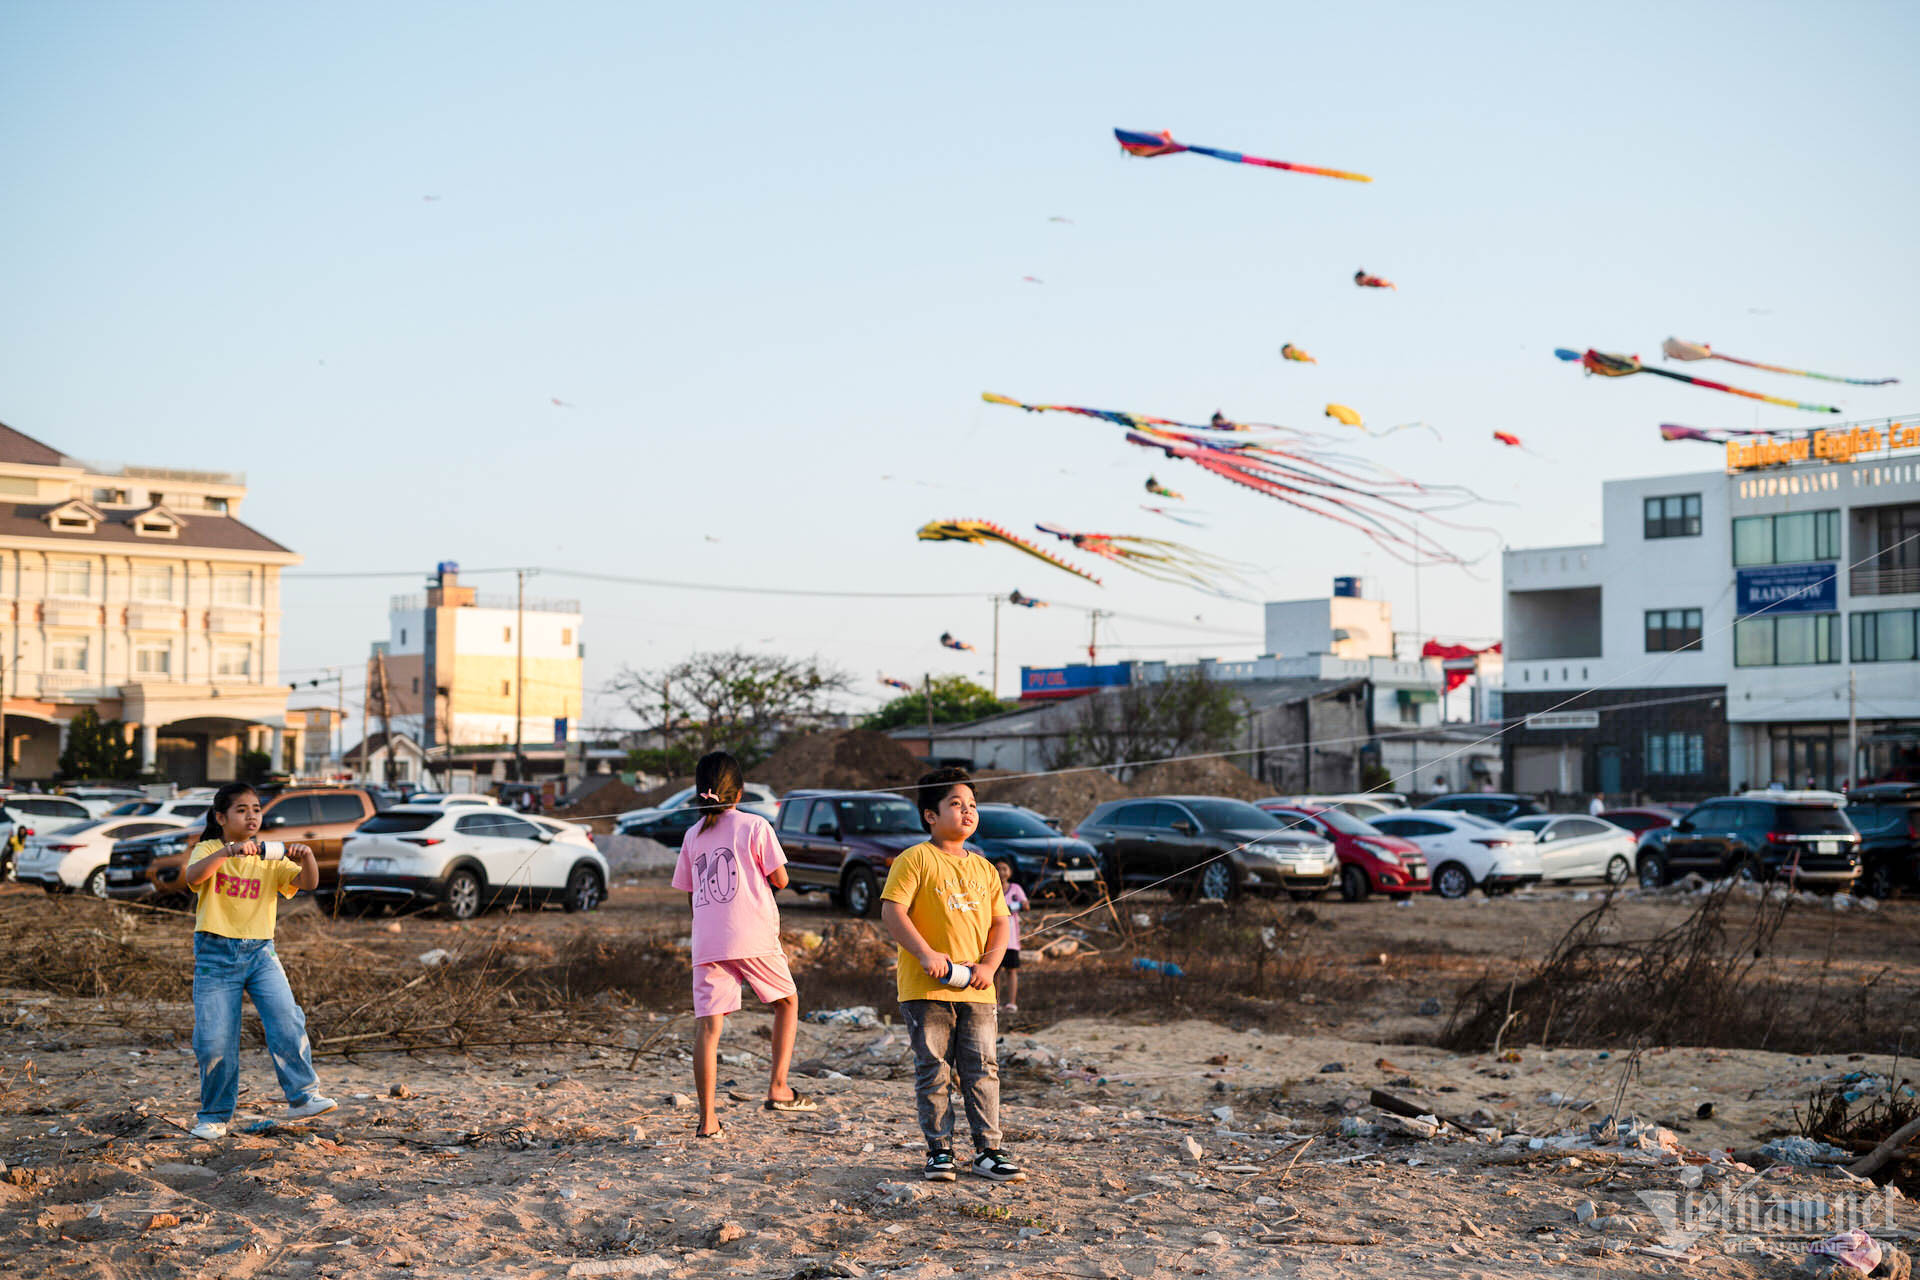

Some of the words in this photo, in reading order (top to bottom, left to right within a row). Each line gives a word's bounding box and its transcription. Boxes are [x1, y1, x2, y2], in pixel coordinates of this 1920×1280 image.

[1726, 436, 1810, 468] Rainbow
[1813, 426, 1882, 463] English
[1749, 584, 1824, 602] RAINBOW
[1029, 672, 1045, 687] PV
[1046, 671, 1067, 686] OIL
[215, 872, 261, 899] F379
[694, 847, 740, 908] 10
